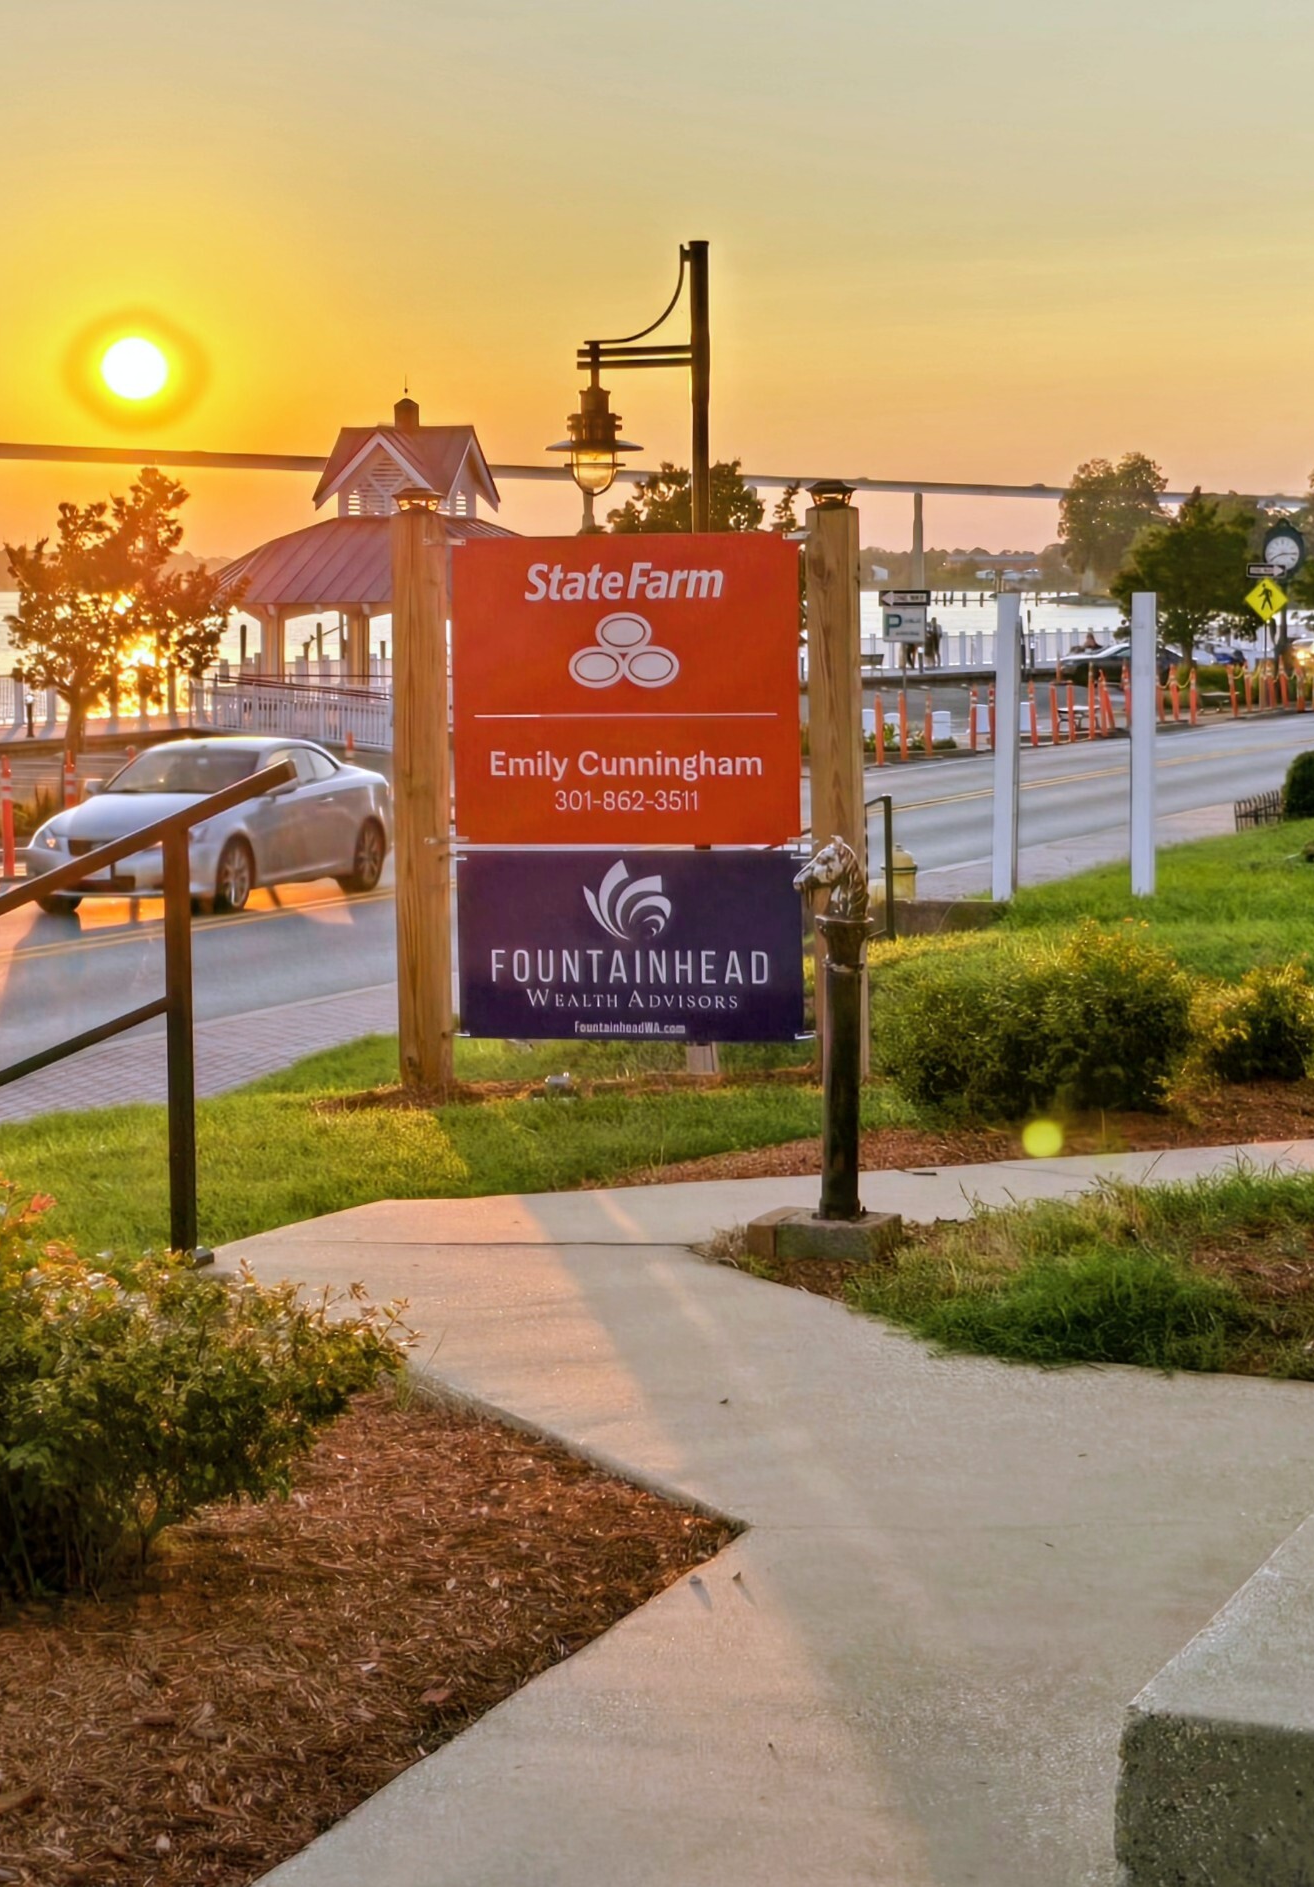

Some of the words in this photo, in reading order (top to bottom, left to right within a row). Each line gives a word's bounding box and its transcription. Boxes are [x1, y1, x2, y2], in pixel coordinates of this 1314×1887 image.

[885, 614, 902, 636] P
[490, 750, 568, 782] Emily
[578, 750, 762, 782] Cunningham
[555, 790, 699, 812] 301-862-3511
[491, 949, 769, 985] FOUNTAINHEAD
[574, 1020, 686, 1034] FountainheadWA.com
